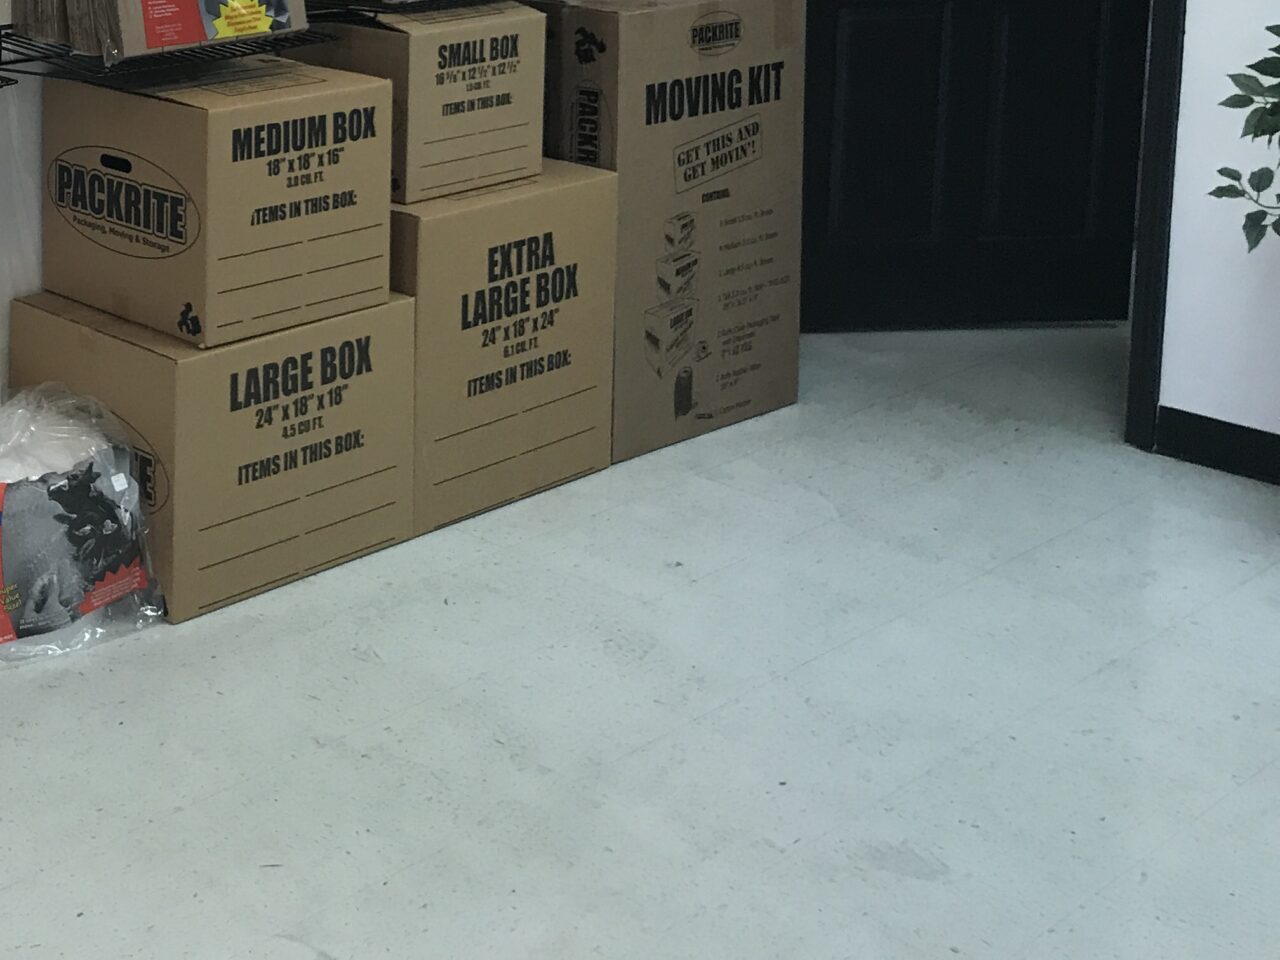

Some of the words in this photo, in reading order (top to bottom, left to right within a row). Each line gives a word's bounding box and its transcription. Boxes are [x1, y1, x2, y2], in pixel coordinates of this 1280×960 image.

[437, 38, 486, 70] SMALL
[489, 33, 519, 62] BOX
[689, 21, 741, 45] PACKRITE
[442, 100, 466, 117] ITEMS
[466, 99, 475, 113] IN
[476, 95, 494, 111] THIS
[645, 68, 742, 126] MOVING
[748, 60, 785, 106] KIT
[231, 114, 327, 163] MEDIUM
[332, 106, 377, 145] BOX
[677, 144, 704, 167] GET
[704, 131, 733, 157] THIS
[736, 120, 760, 142] AND
[266, 157, 286, 177] 18"
[296, 152, 315, 172] 18"
[326, 146, 345, 166] 16"
[683, 163, 708, 182] GET
[56, 162, 187, 246] PACKRITE
[250, 203, 287, 226] ITEMS
[288, 200, 301, 219] IN
[303, 195, 330, 216] THIS
[331, 190, 358, 210] BOX:
[487, 231, 556, 284] EXTRA
[461, 276, 531, 331] LARGE
[535, 262, 578, 309] BOX
[481, 325, 501, 348] 24"
[512, 316, 530, 339] 18"
[540, 308, 560, 330] 24"
[230, 351, 314, 412] LARGE
[321, 335, 373, 386] BOX
[467, 370, 503, 398] ITEMS
[504, 365, 518, 386] IN
[519, 356, 545, 381] THIS
[547, 349, 572, 373] BOX:
[255, 403, 280, 430] 24"
[292, 393, 315, 418] 18"
[326, 384, 350, 408] 18"
[237, 454, 281, 486] ITEMS
[283, 449, 298, 472] IN
[300, 438, 332, 466] THIS
[334, 429, 365, 456] BOX:
